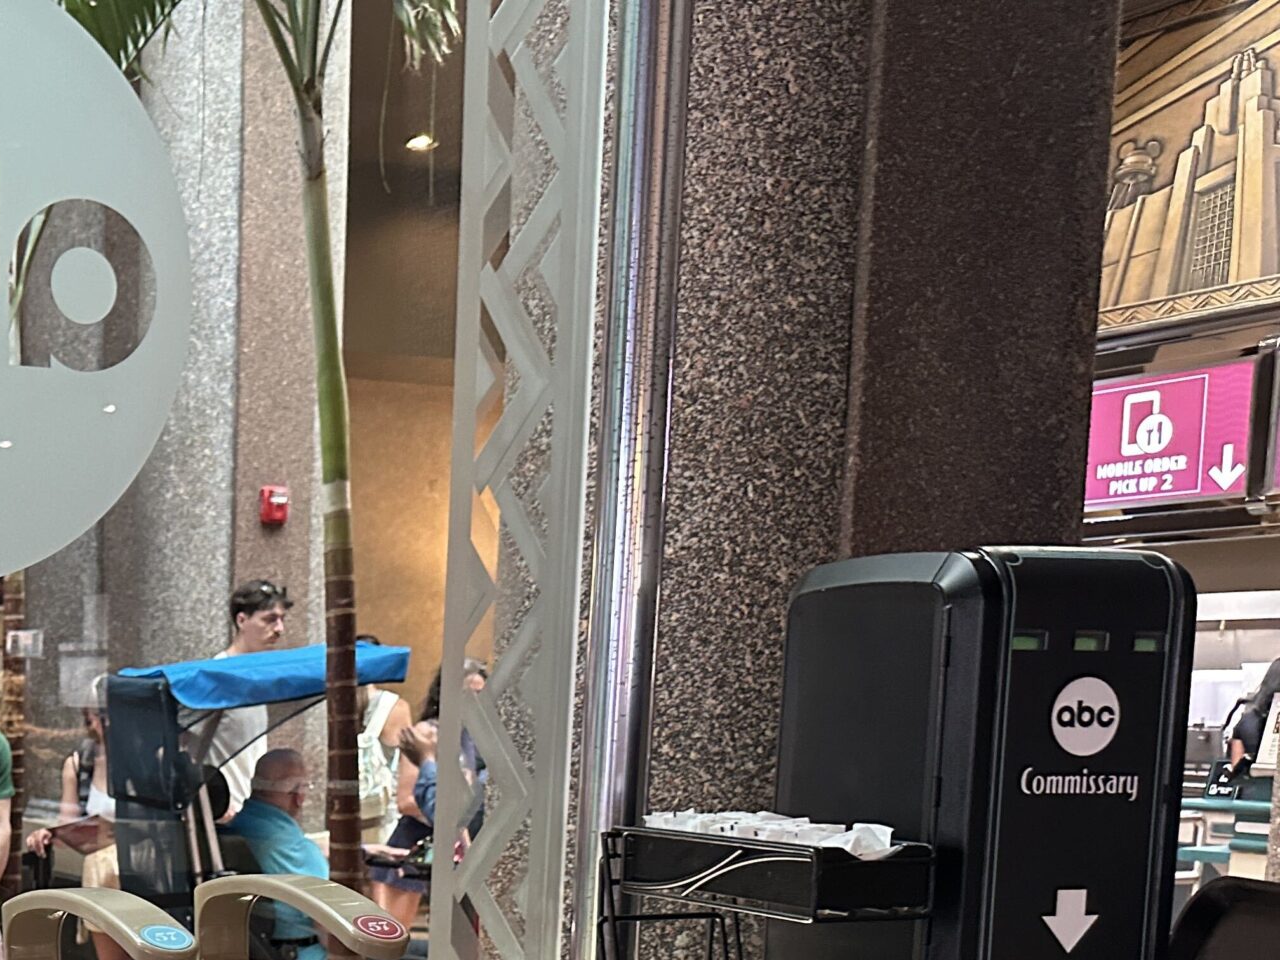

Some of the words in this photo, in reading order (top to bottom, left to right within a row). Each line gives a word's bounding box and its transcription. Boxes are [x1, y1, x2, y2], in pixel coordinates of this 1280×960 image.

[1096, 458, 1142, 480] MOBILE
[1144, 454, 1188, 475] ORDER
[1108, 478, 1138, 496] PICK
[1139, 476, 1159, 492] UP
[1160, 474, 1174, 491] 2
[1056, 700, 1116, 728] abc
[1020, 767, 1139, 801] Commissary
[154, 931, 177, 941] 57
[368, 920, 390, 931] 57
